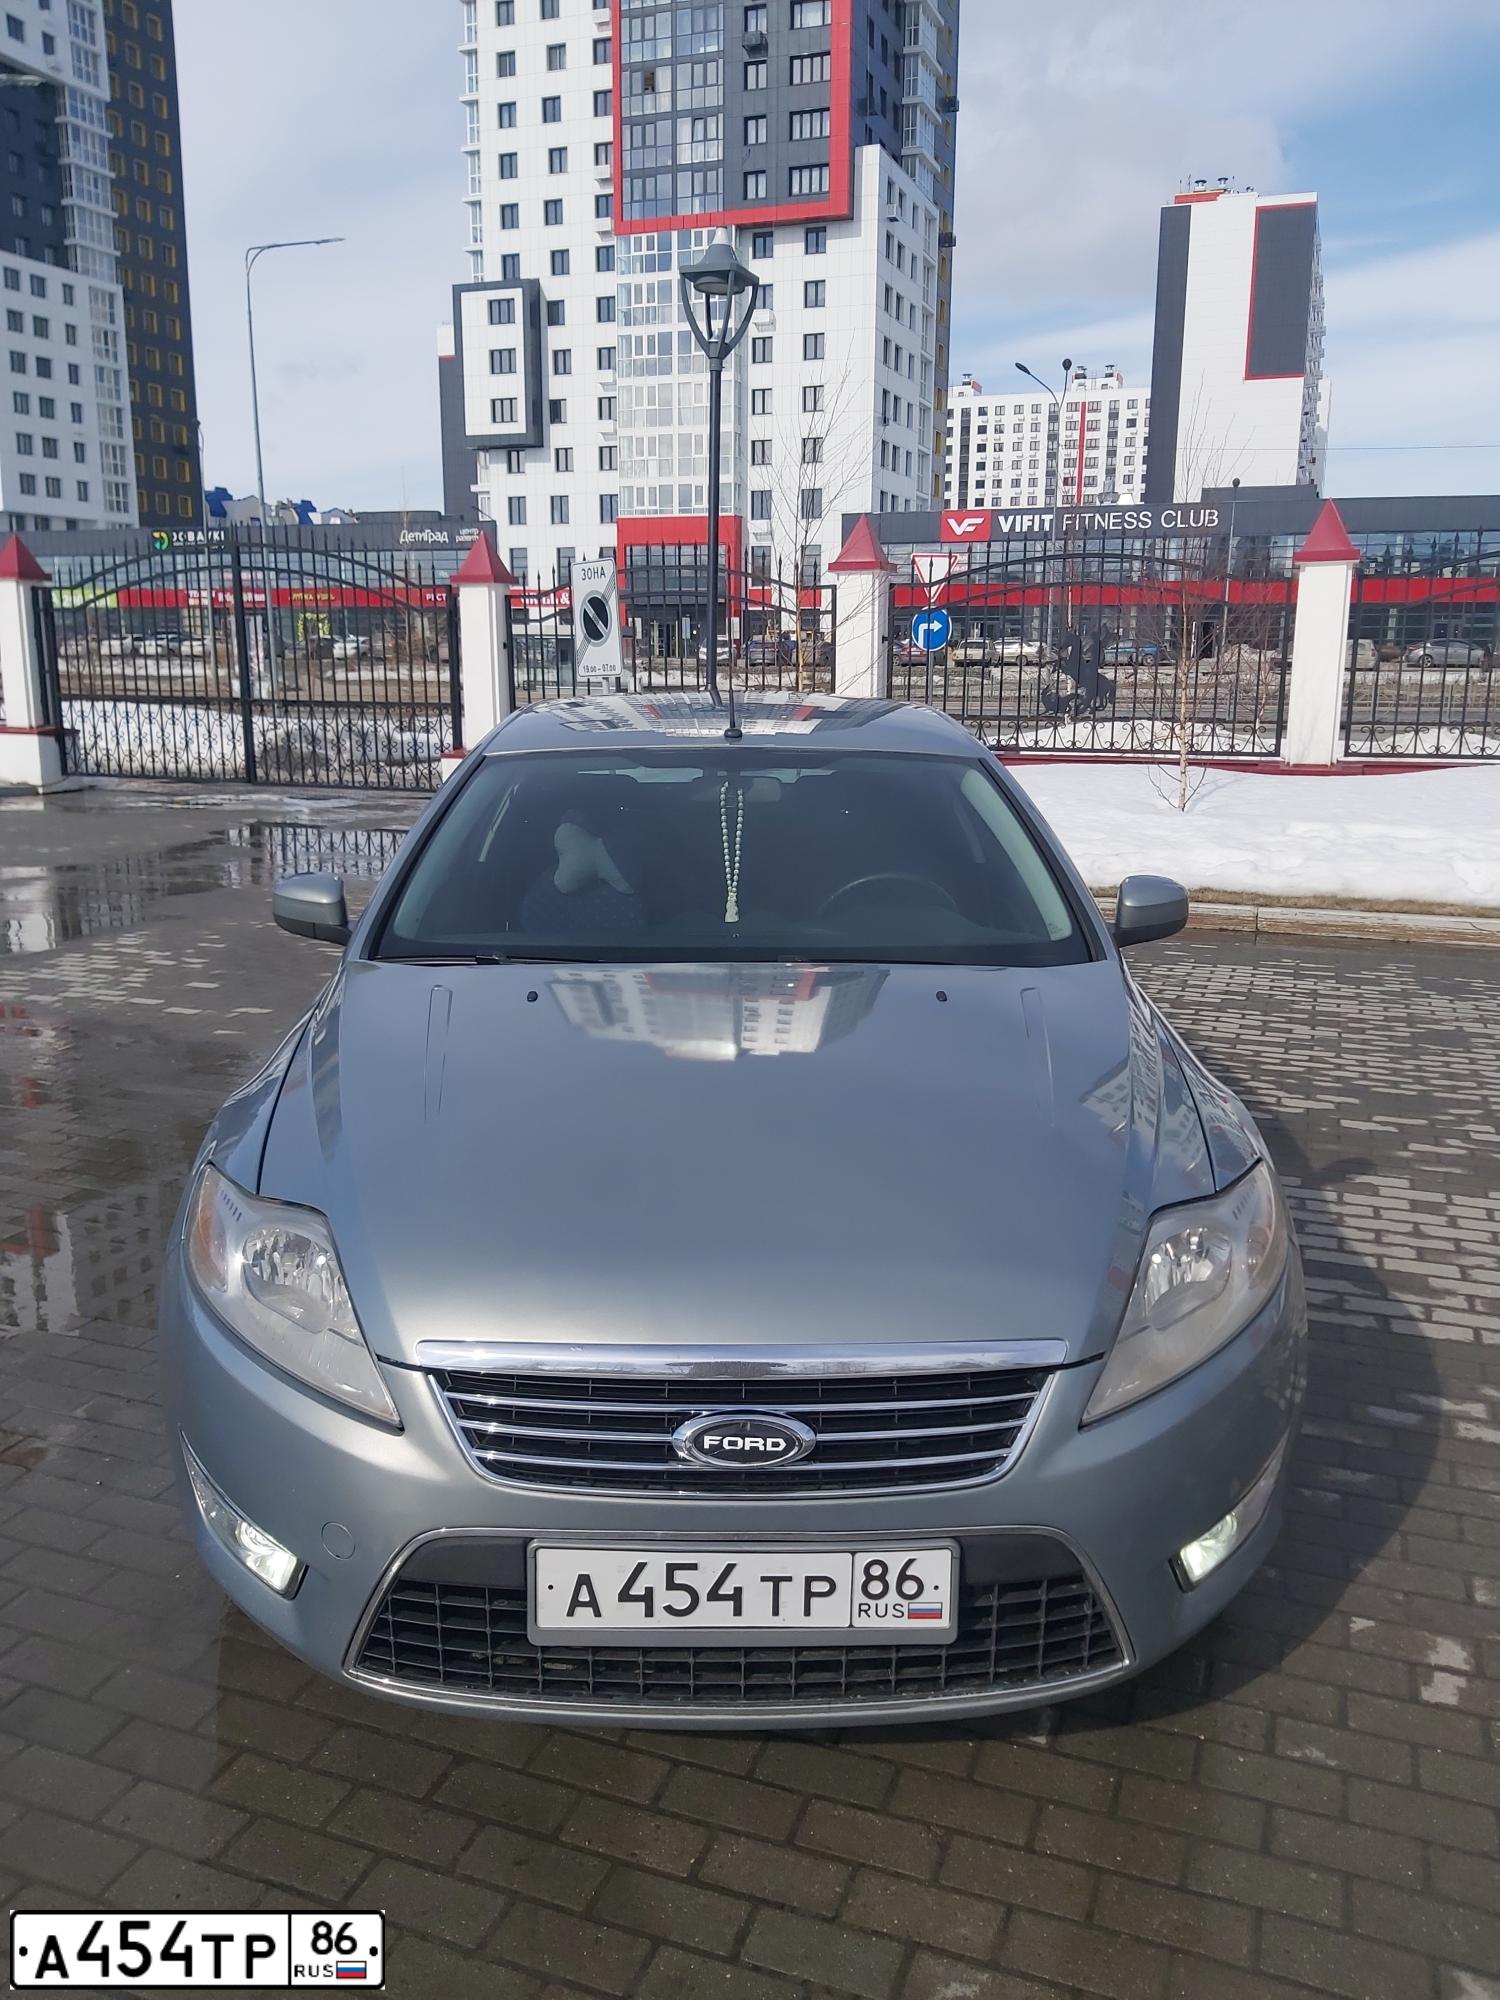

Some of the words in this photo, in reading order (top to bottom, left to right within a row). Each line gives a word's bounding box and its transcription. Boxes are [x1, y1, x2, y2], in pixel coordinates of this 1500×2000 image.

[998, 514, 1053, 533] VIFIT
[1062, 511, 1152, 532] FITNESS
[1160, 508, 1219, 528] CLUB
[581, 566, 606, 581] ЗОНА
[703, 1436, 787, 1452] FORD
[565, 1561, 838, 1619] А454ТР
[860, 1558, 925, 1601] 86
[857, 1602, 905, 1620] RUS
